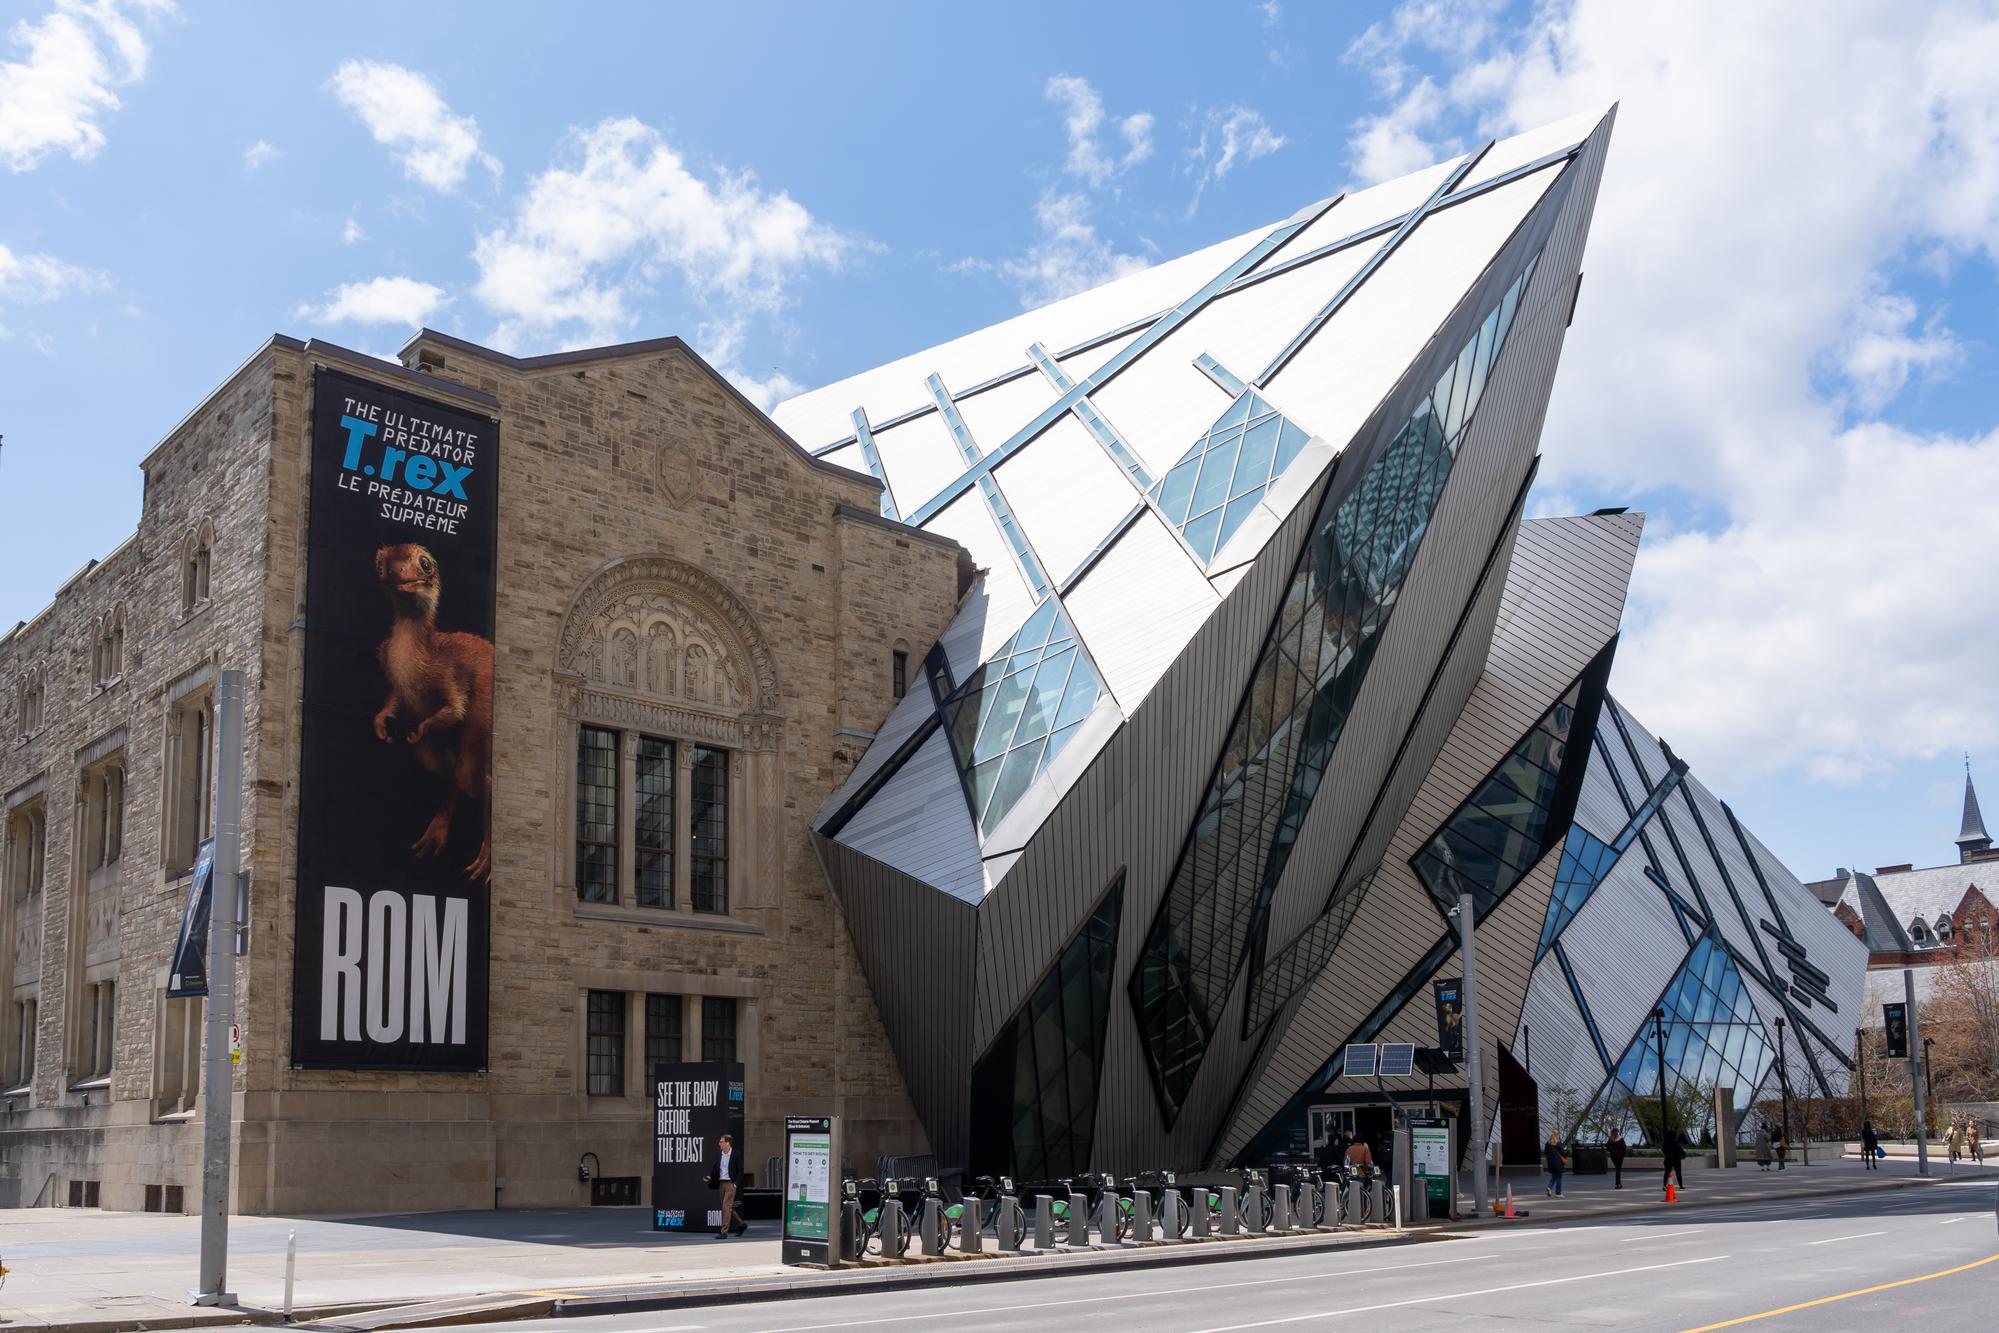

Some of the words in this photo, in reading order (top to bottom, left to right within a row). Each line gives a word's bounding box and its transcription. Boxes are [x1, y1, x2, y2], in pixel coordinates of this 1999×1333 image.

[344, 397, 382, 423] THE
[384, 410, 478, 450] ULTIMATE
[340, 415, 474, 500] T.rex
[382, 428, 475, 466] PREDATOR
[338, 473, 362, 492] LE
[367, 481, 468, 520] PRÉDATEUR
[380, 503, 460, 535] SUPRÊME
[320, 885, 469, 1045] ROM
[657, 1081, 673, 1107] SEE
[675, 1081, 692, 1107] THE
[694, 1080, 719, 1107] BABY
[657, 1109, 691, 1135] BEFORE
[657, 1137, 674, 1163] THE
[676, 1136, 704, 1163] BEAST
[657, 1213, 685, 1227] T.rex
[707, 1210, 722, 1227] ROM
